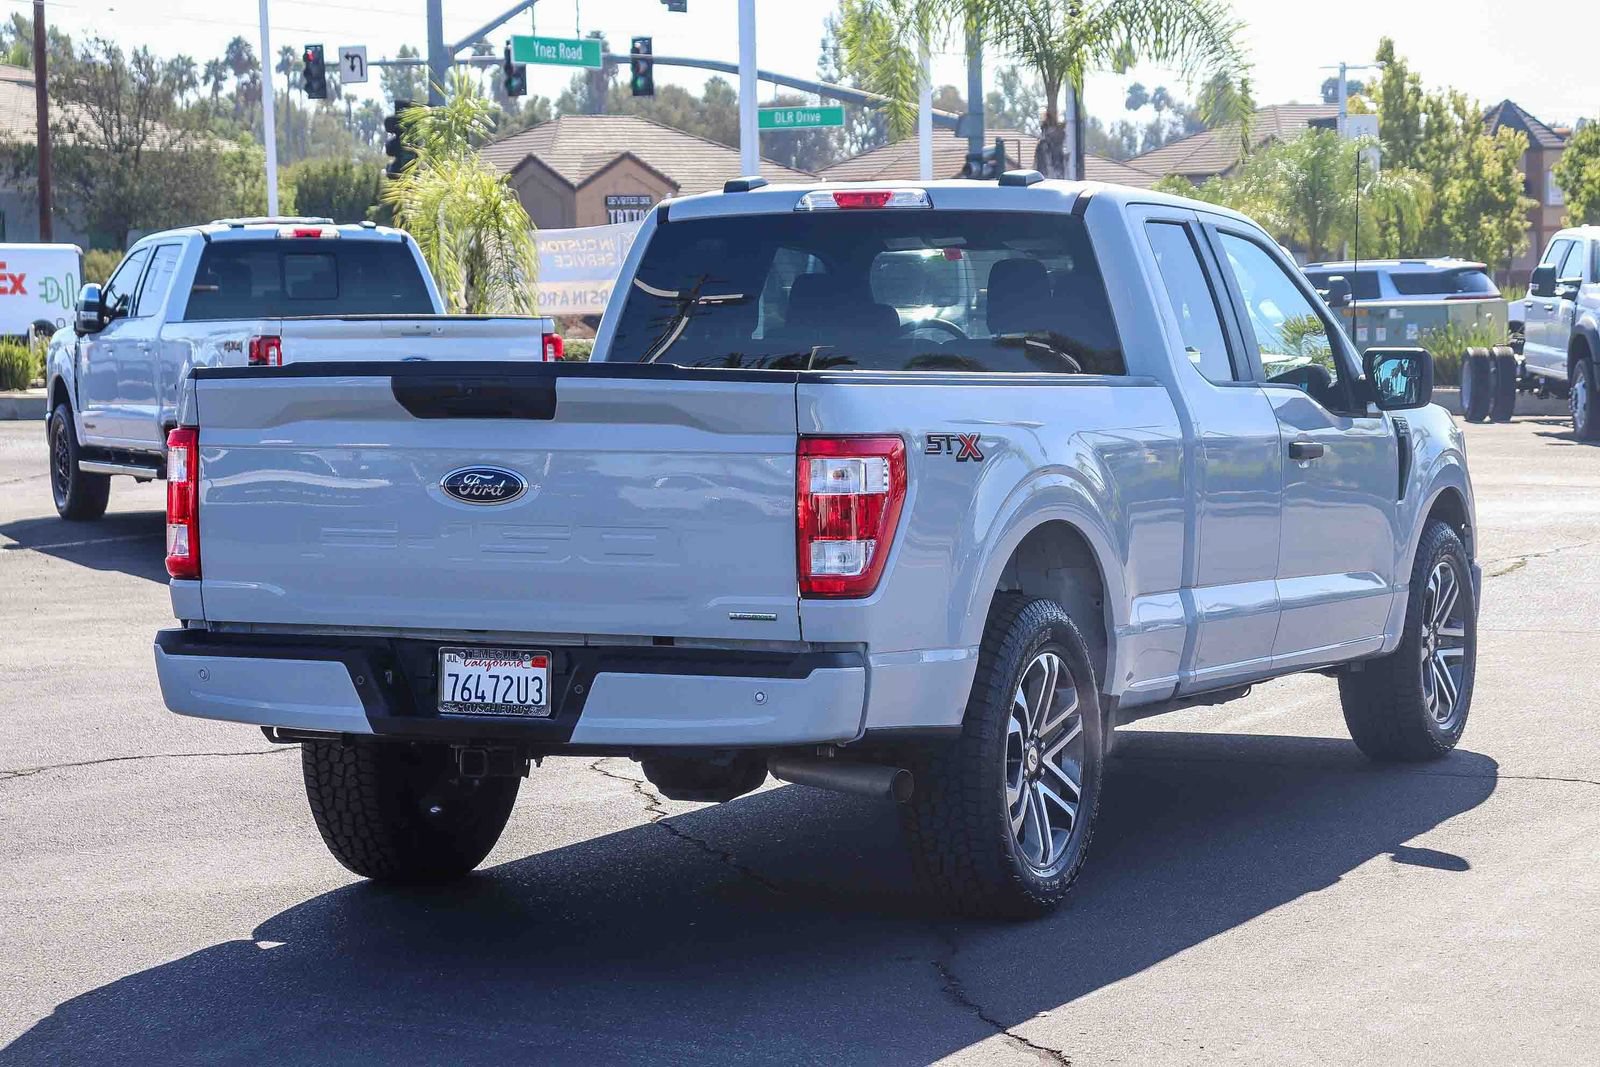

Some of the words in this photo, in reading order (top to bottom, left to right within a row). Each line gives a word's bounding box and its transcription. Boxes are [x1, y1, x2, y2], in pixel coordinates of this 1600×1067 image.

[533, 40, 557, 58] Ynez
[559, 43, 583, 60] Road
[796, 111, 821, 123] Drive
[924, 432, 985, 462] STX
[459, 473, 506, 497] Ford
[463, 658, 525, 672] California
[447, 673, 544, 705] 76472U3
